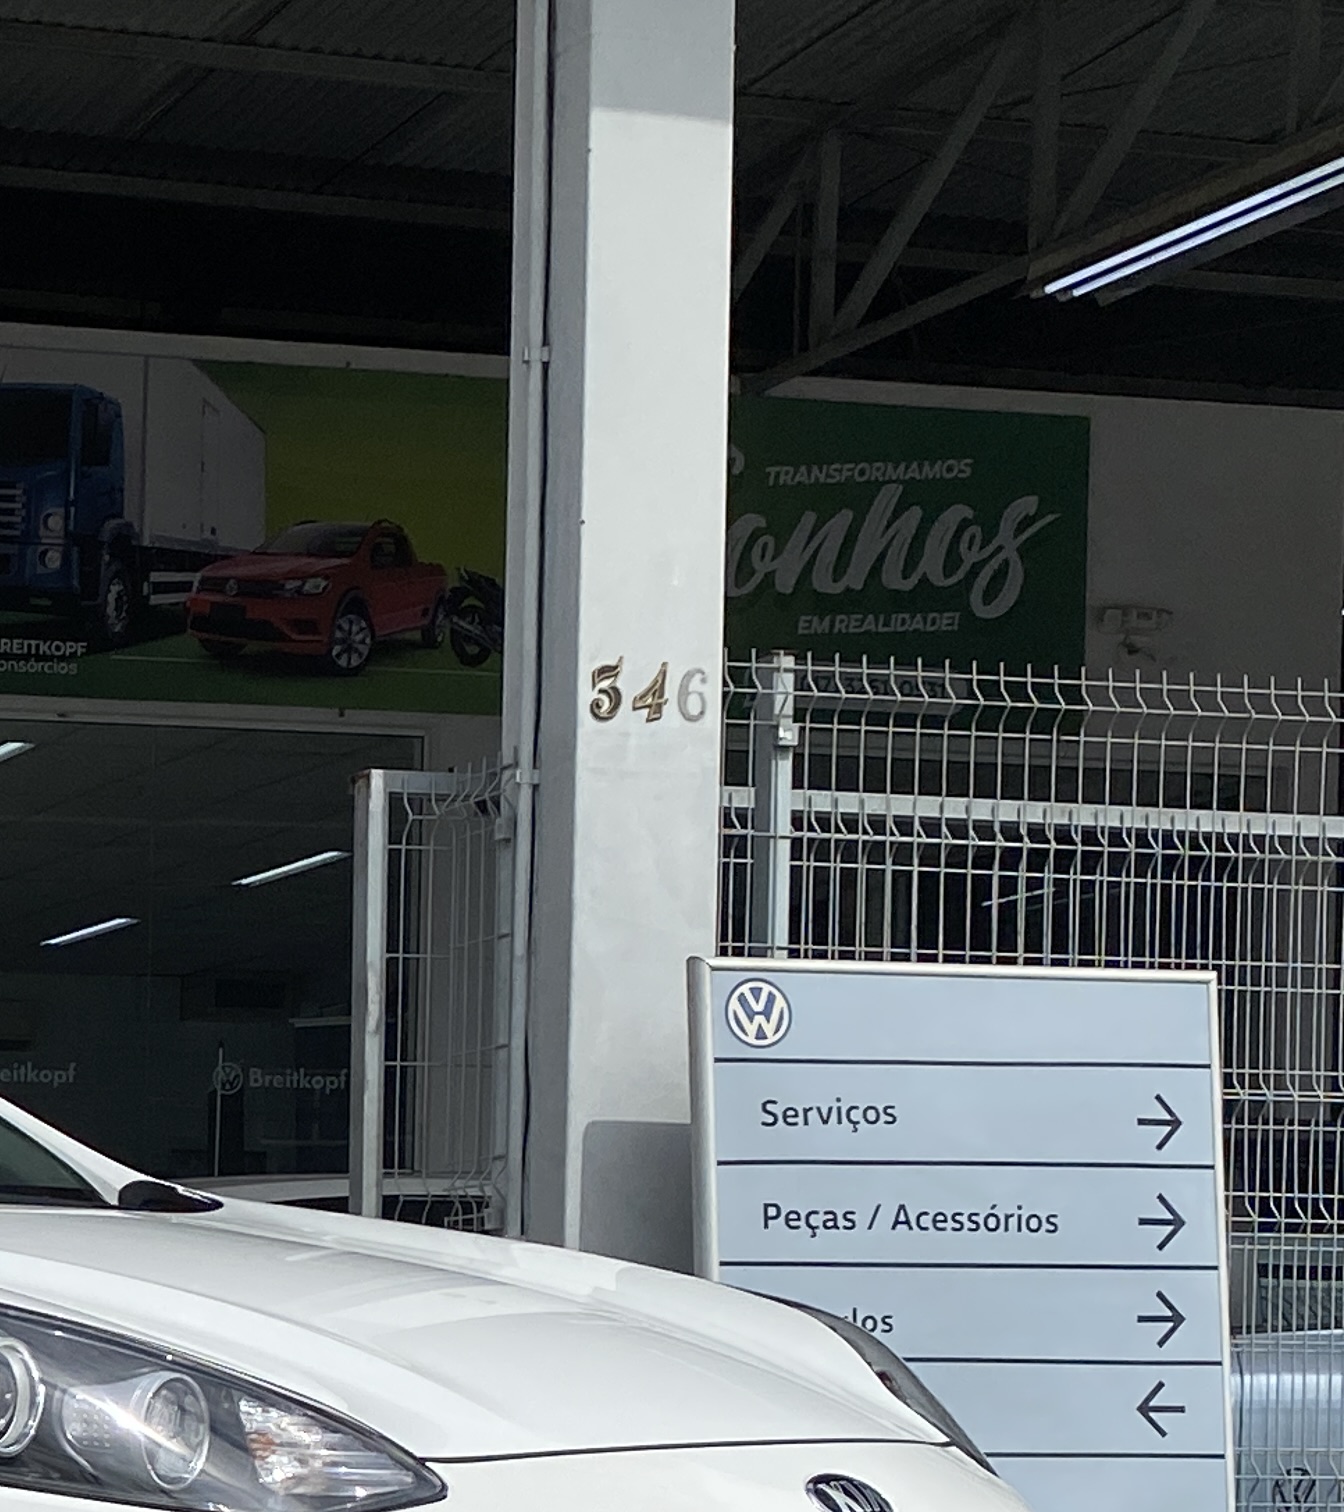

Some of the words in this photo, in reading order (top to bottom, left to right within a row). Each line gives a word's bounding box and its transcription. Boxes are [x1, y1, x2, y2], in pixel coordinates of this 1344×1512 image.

[765, 459, 974, 487] TRANSFORMAMOS
[725, 444, 1061, 619] onhos
[797, 614, 832, 635] EM
[833, 612, 961, 634] REALIDADE!
[249, 1067, 349, 1096] Breitkopf
[760, 1097, 898, 1133] Serviços
[762, 1202, 858, 1239] Peças
[890, 1203, 1060, 1234] Acessórios
